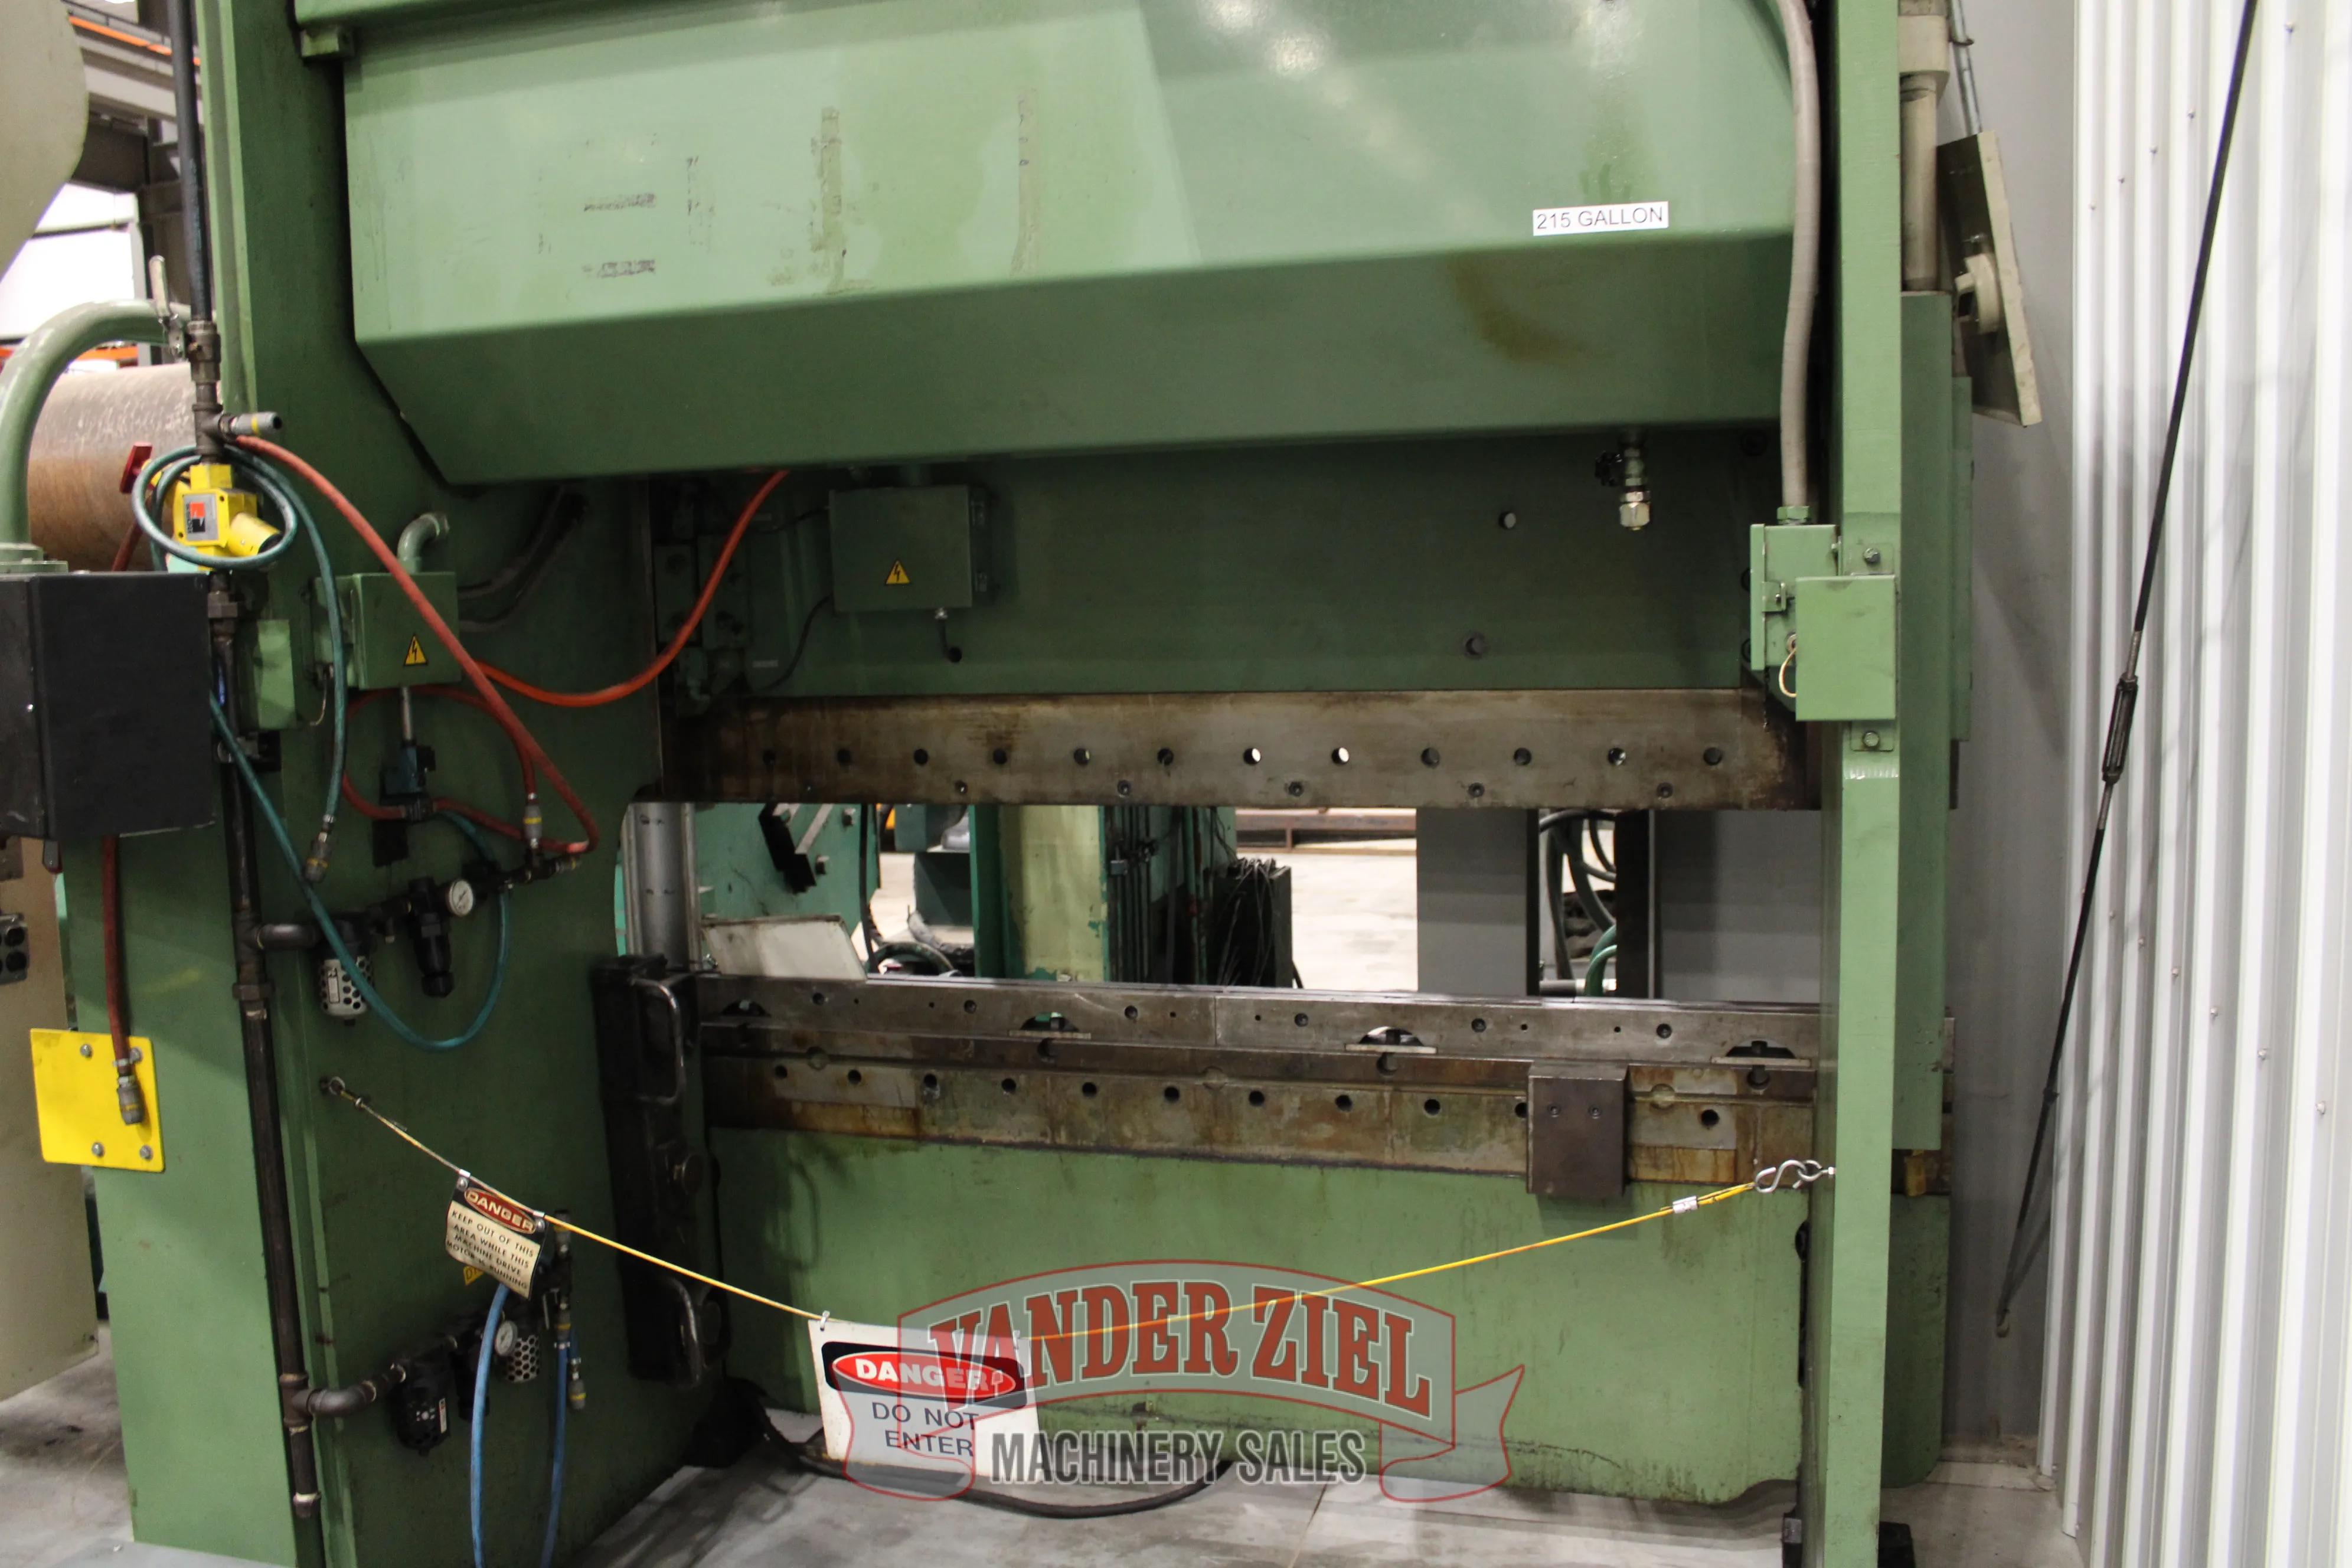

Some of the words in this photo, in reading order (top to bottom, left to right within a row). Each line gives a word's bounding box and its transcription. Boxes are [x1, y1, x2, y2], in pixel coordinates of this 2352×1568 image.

[1537, 212, 1571, 229] 215
[1578, 207, 1662, 227] GALLON
[466, 1191, 534, 1232] DANGER
[452, 1210, 473, 1225] KEEP
[476, 1223, 495, 1237] OUT
[498, 1234, 511, 1245] OF
[515, 1243, 534, 1258] THIS
[453, 1224, 476, 1240] AREA
[480, 1237, 508, 1256] WHILE
[511, 1253, 529, 1269] THIS
[447, 1240, 475, 1260] MOTOR
[489, 1265, 528, 1289] RUNNING
[454, 1234, 492, 1260] MACHINE
[496, 1258, 522, 1276] DRIVE
[855, 1358, 990, 1391] DANGER
[872, 1402, 911, 1423] DO
[925, 1407, 980, 1431] NOT
[884, 1429, 974, 1458] ENTER
